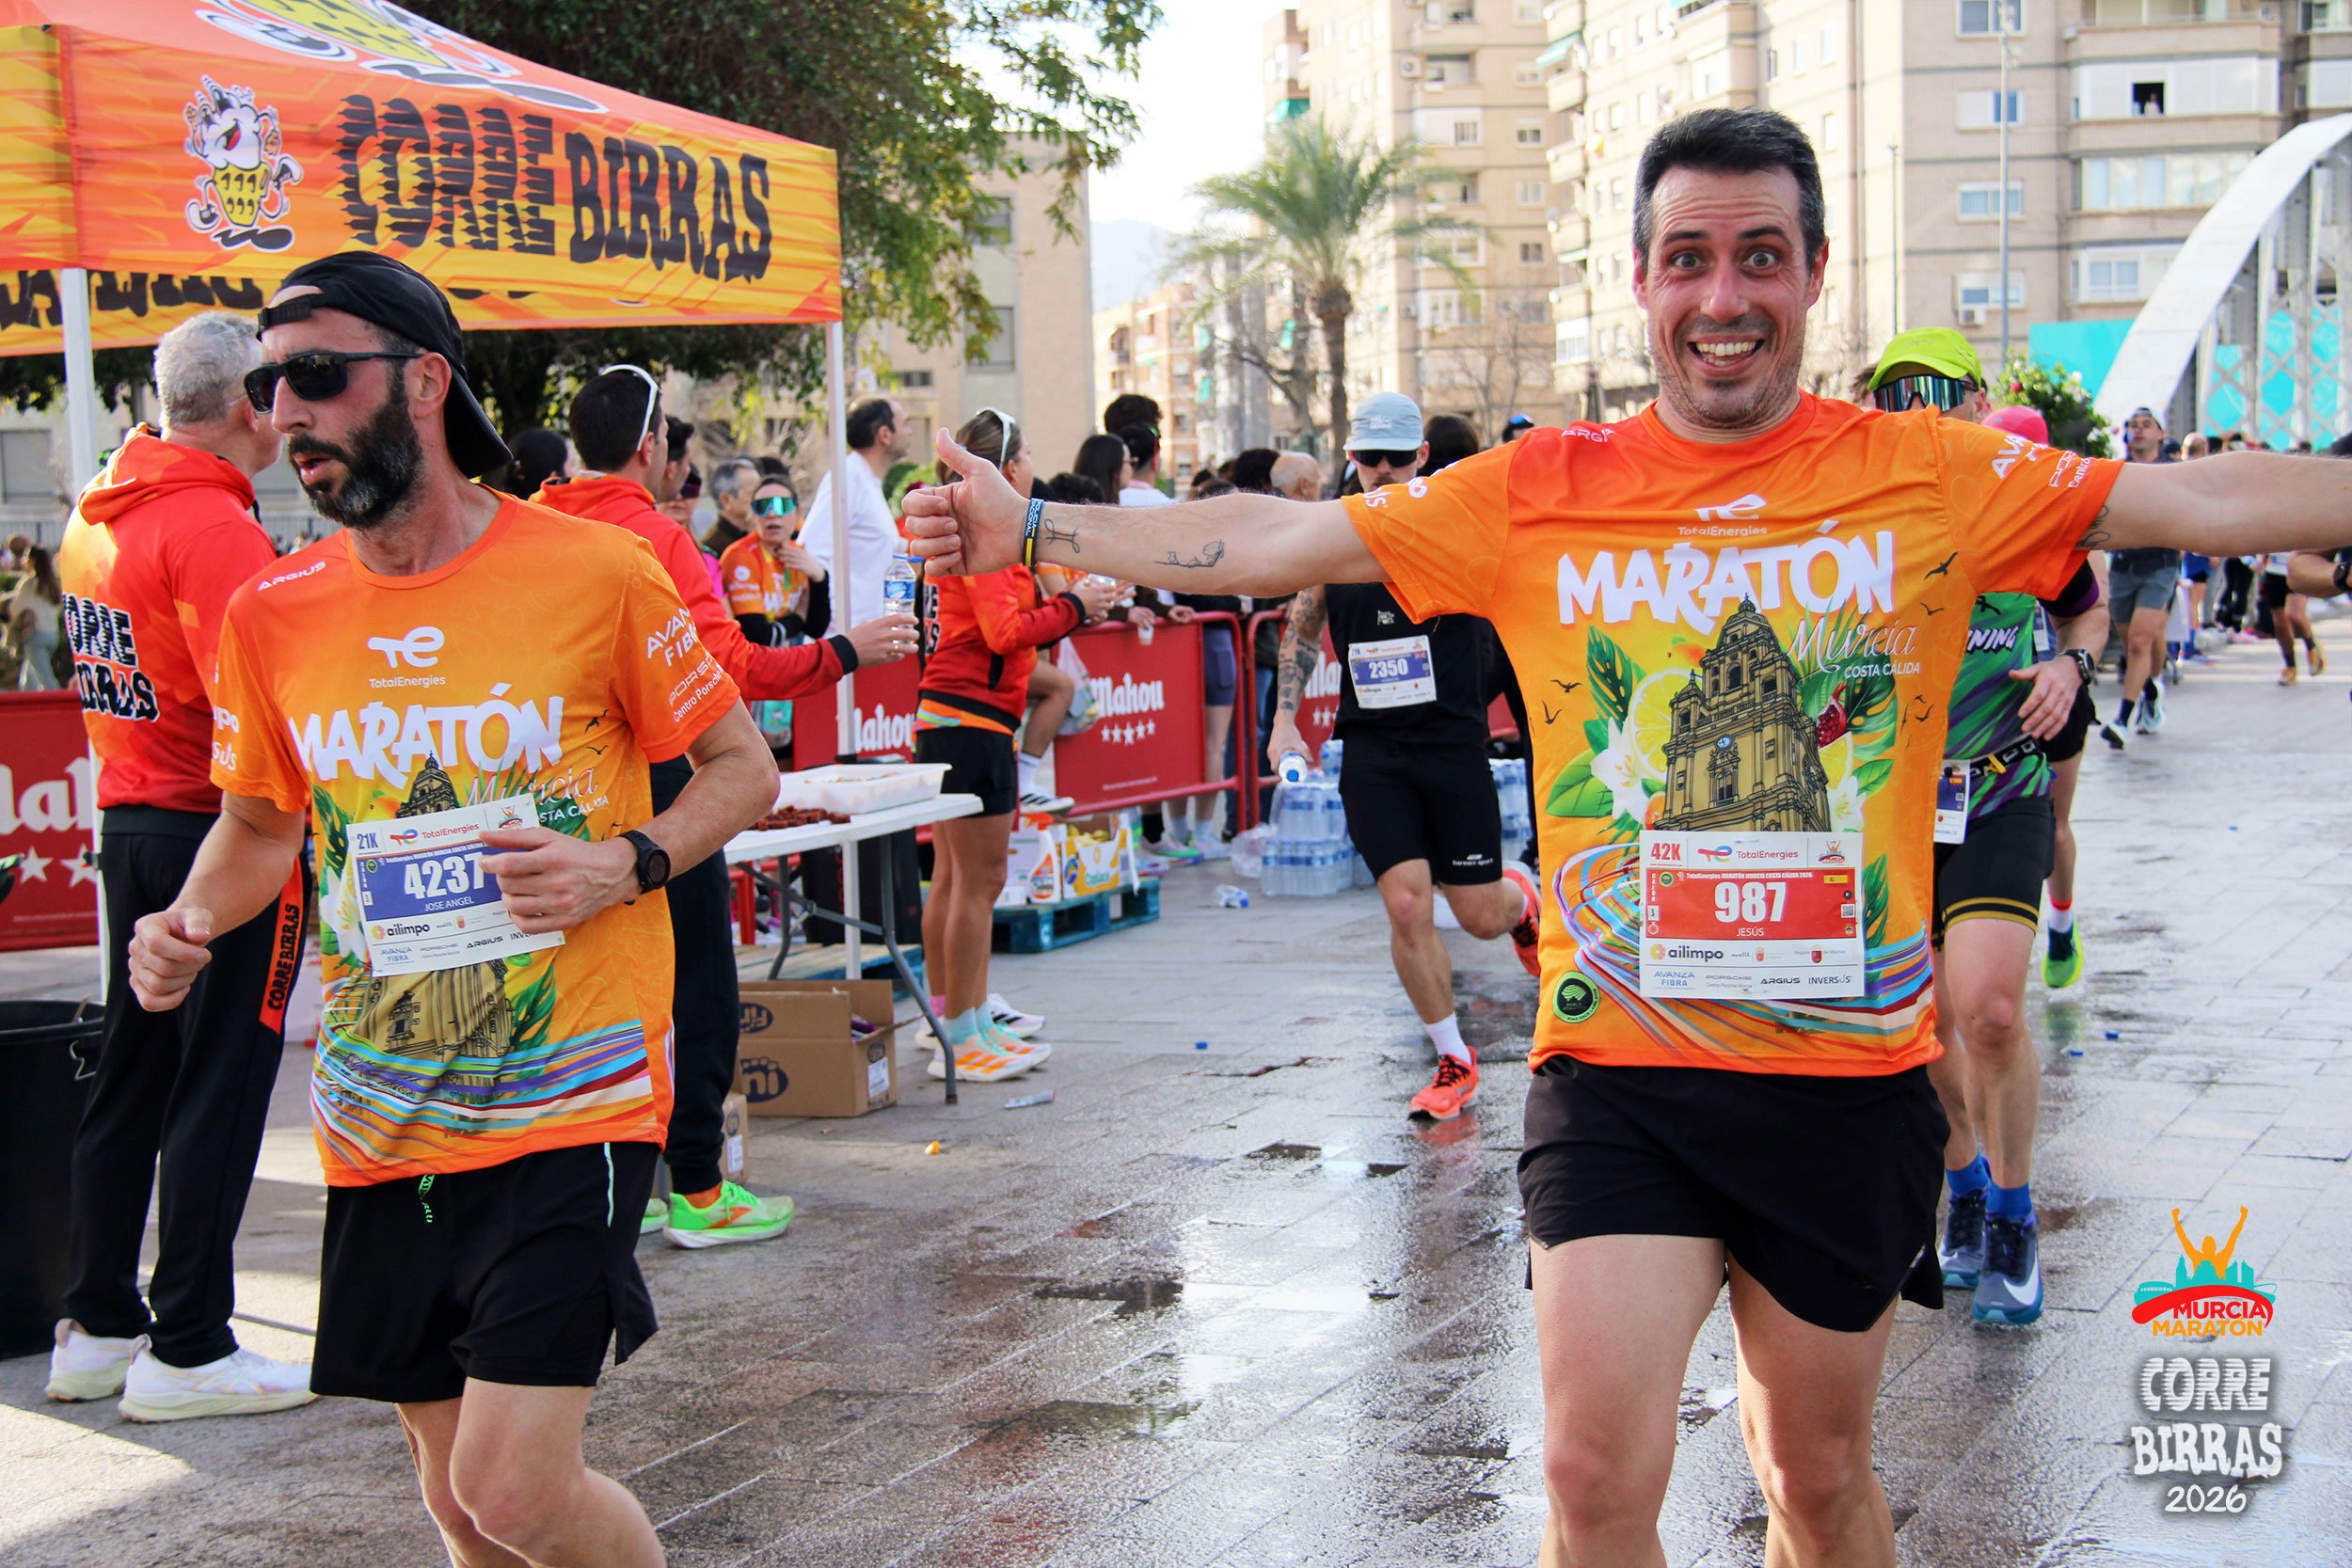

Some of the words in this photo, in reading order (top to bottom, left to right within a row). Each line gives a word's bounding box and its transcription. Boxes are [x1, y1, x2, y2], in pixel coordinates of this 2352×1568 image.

[336, 94, 555, 256] CORRE
[566, 131, 773, 282] BIRRAS
[1677, 525, 1768, 537] TotalEnergies
[258, 561, 326, 591] ARGIUS
[1558, 519, 1893, 636] MARATÓN
[1786, 616, 1917, 673] Murcia
[1369, 658, 1409, 679] 2350
[1844, 663, 1881, 678] COSTA
[1883, 659, 1920, 675] CÁLIDA
[369, 674, 446, 689] TotalEnergies
[1089, 672, 1165, 718] Mahou
[674, 696, 698, 722] Centro
[287, 682, 564, 790] MARATÓN
[357, 832, 378, 849] 21K
[421, 823, 480, 840] TotalEnergies
[1650, 843, 1681, 861] 42K
[1737, 849, 1799, 861] TotalEnergies
[405, 851, 485, 900] 4237
[424, 900, 445, 912] JOSE
[445, 896, 475, 910] ANGEL
[1714, 881, 1787, 923] 987
[279, 903, 300, 961] BIRRAS
[387, 923, 430, 938] ailimpo
[1736, 926, 1765, 938] JESÚS
[466, 936, 504, 949] ARGIUS
[387, 954, 409, 962] FIBRA
[1668, 944, 1724, 962] ailimpo
[267, 960, 294, 1011] CORRE
[1760, 976, 1800, 985] ARGIUS
[1808, 974, 1852, 985] INVERSUS
